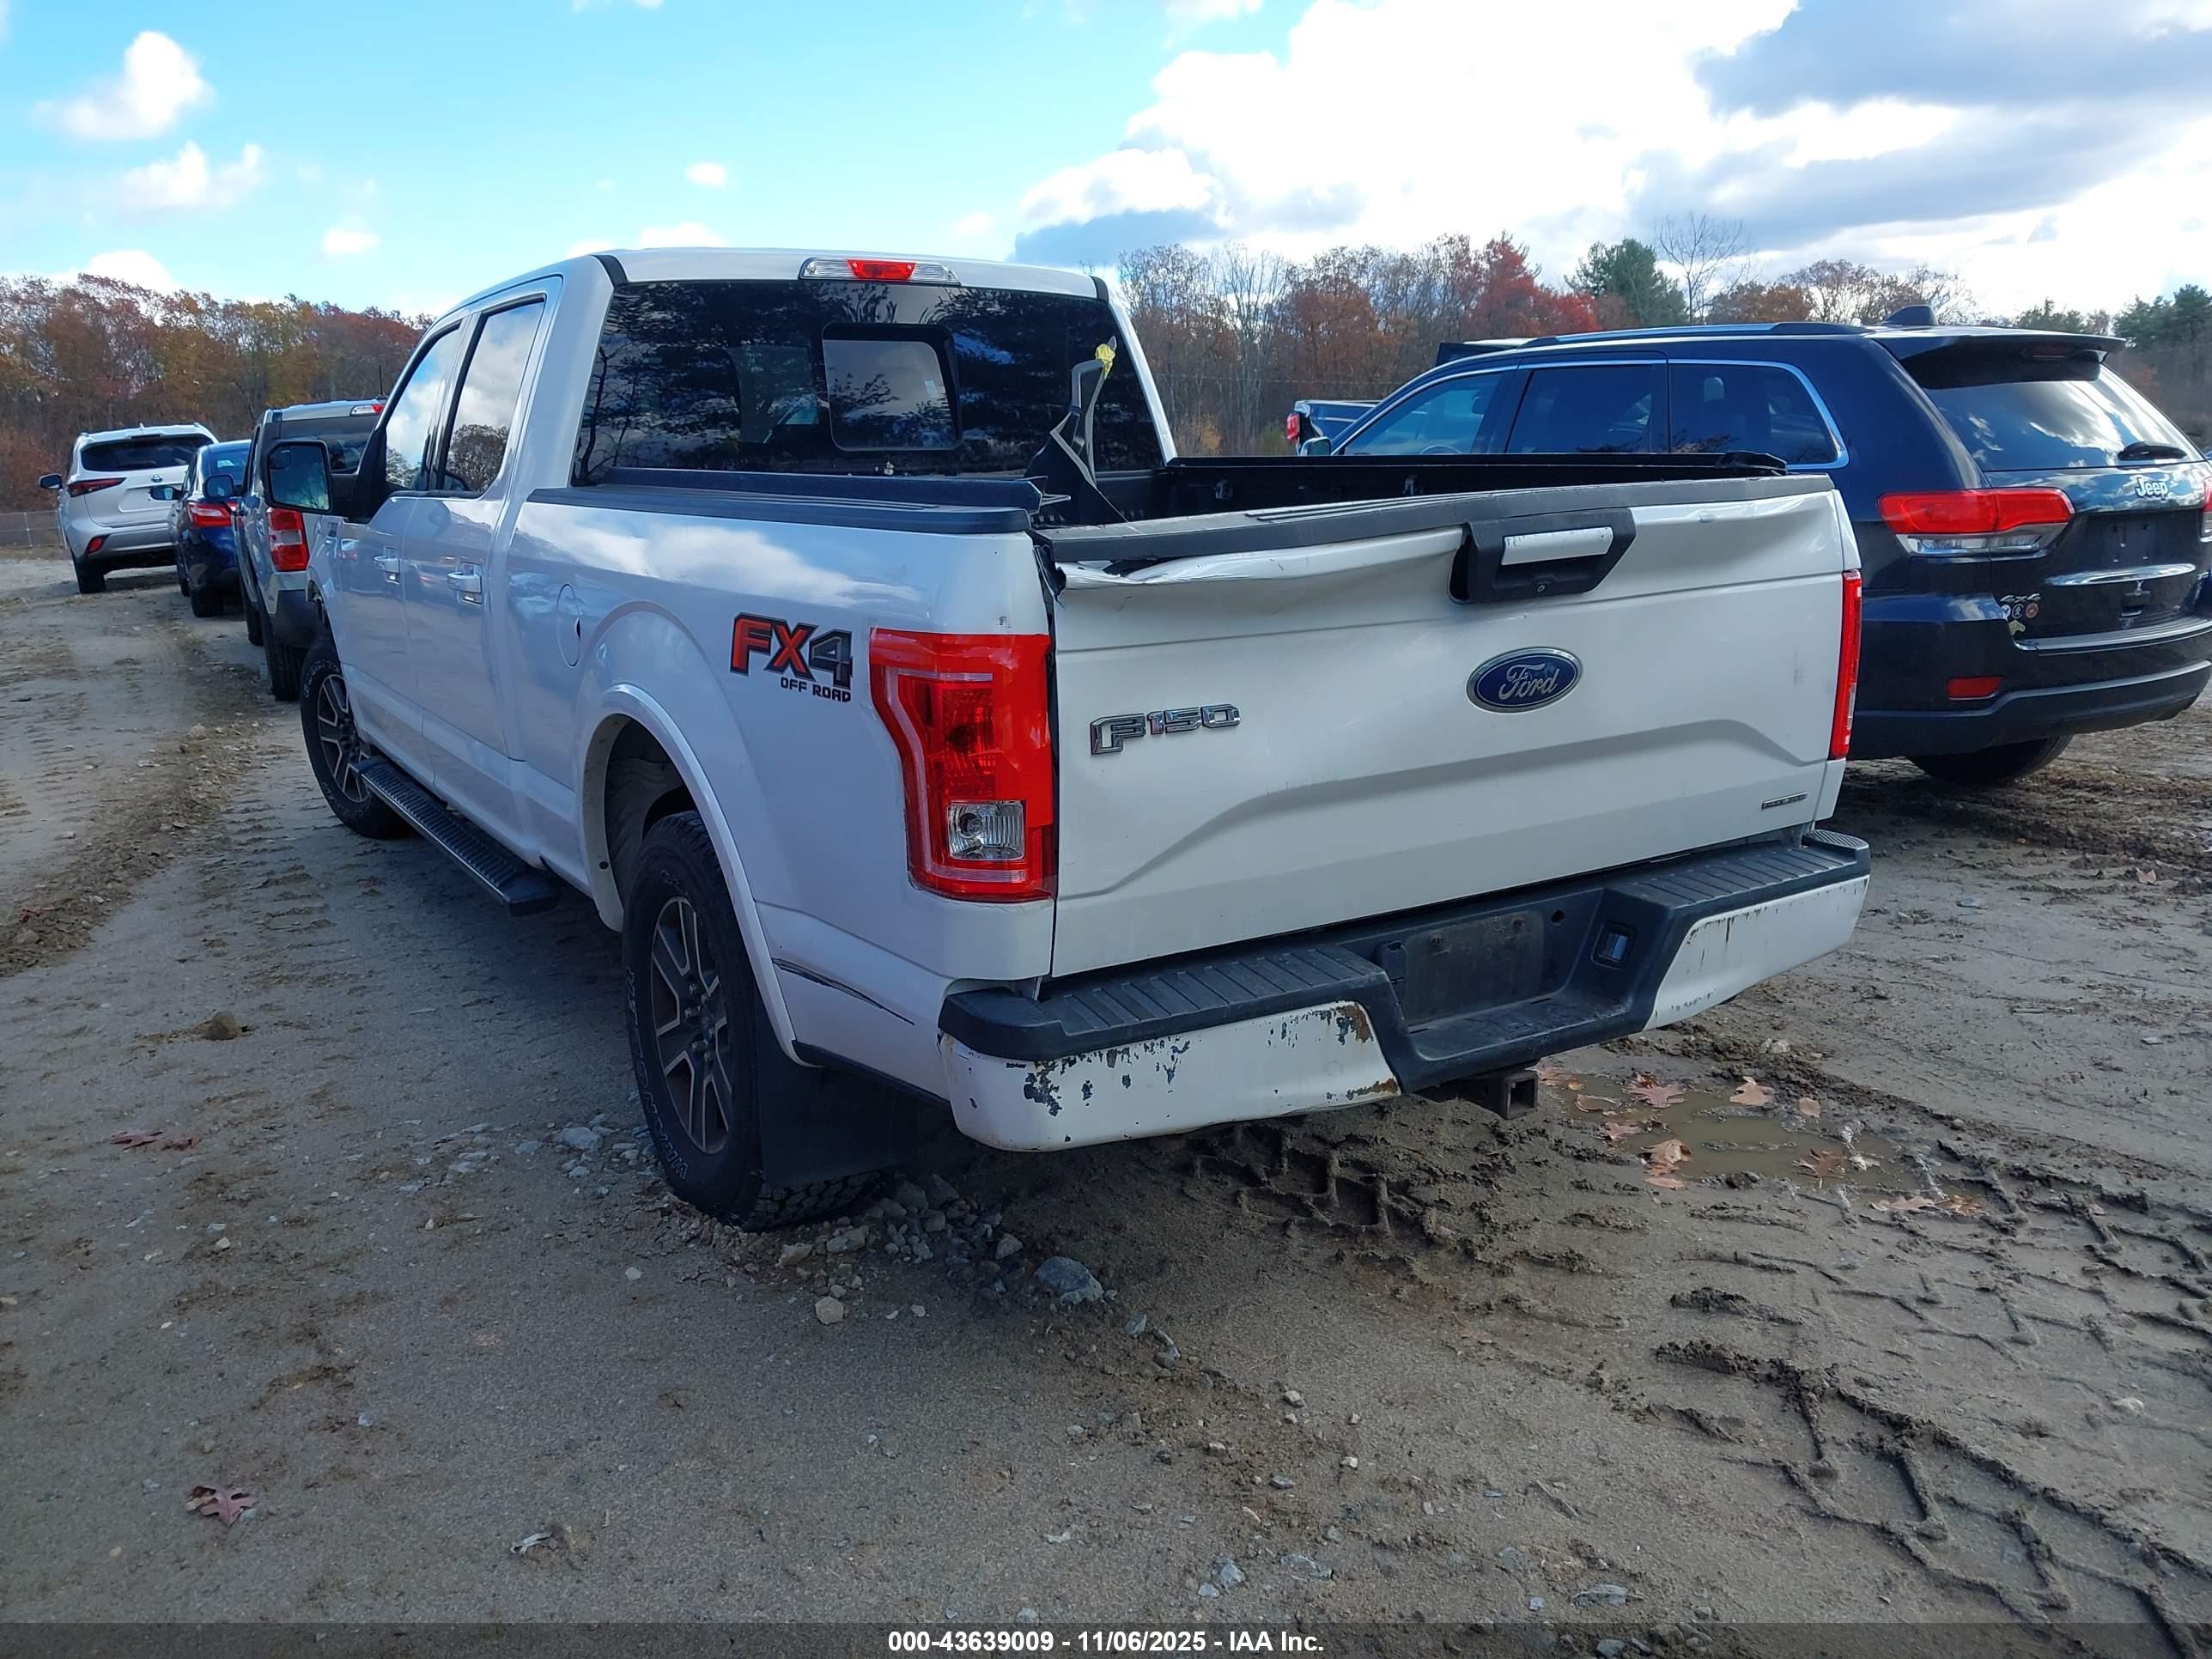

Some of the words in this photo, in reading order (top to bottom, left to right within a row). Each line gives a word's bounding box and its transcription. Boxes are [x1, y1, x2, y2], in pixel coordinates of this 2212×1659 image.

[2135, 477, 2169, 501] Jeep
[730, 611, 854, 690] FX4
[780, 676, 808, 692] OFF
[812, 684, 852, 703] ROAD
[1498, 663, 1560, 701] Ford
[1090, 703, 1242, 757] F150
